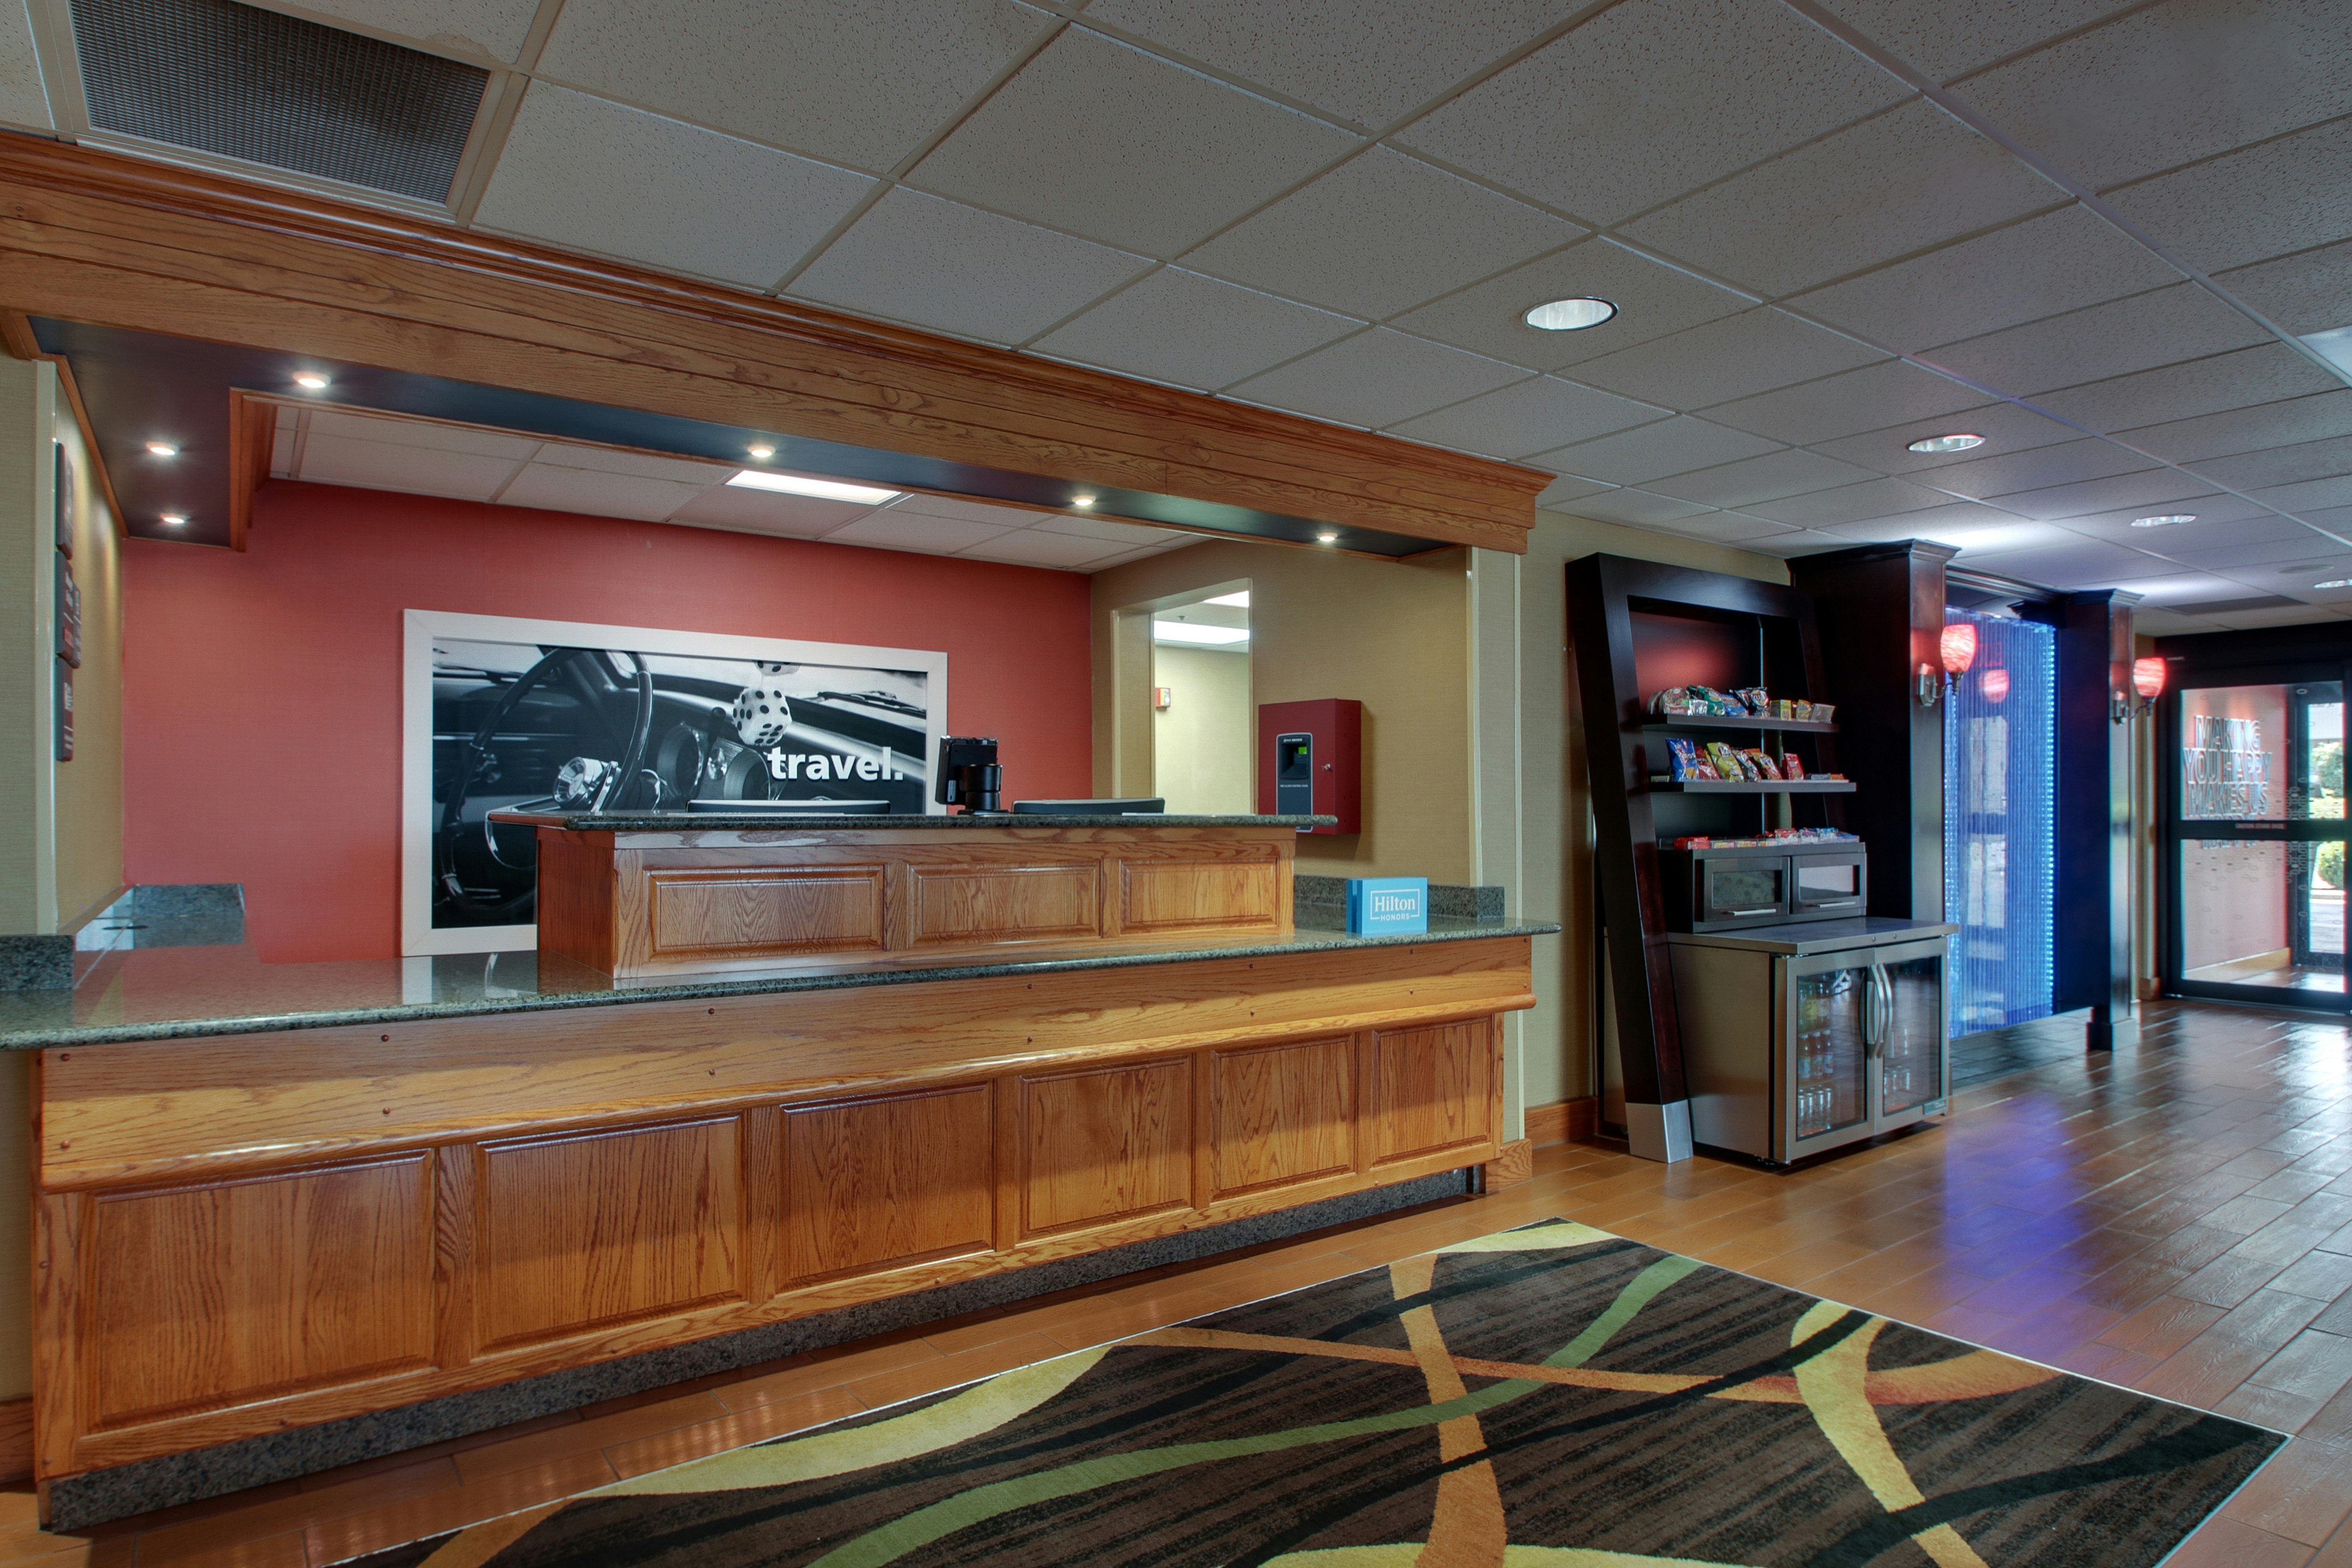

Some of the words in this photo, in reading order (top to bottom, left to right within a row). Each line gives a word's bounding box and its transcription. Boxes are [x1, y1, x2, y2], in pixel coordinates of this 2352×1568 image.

[2195, 714, 2262, 753] MAKING
[767, 746, 903, 781] travel.
[2183, 747, 2220, 784] YOU
[2222, 748, 2273, 784] HAPPY
[2187, 781, 2247, 817] MAKES
[2249, 782, 2269, 815] US
[1374, 894, 1415, 912] Hilton
